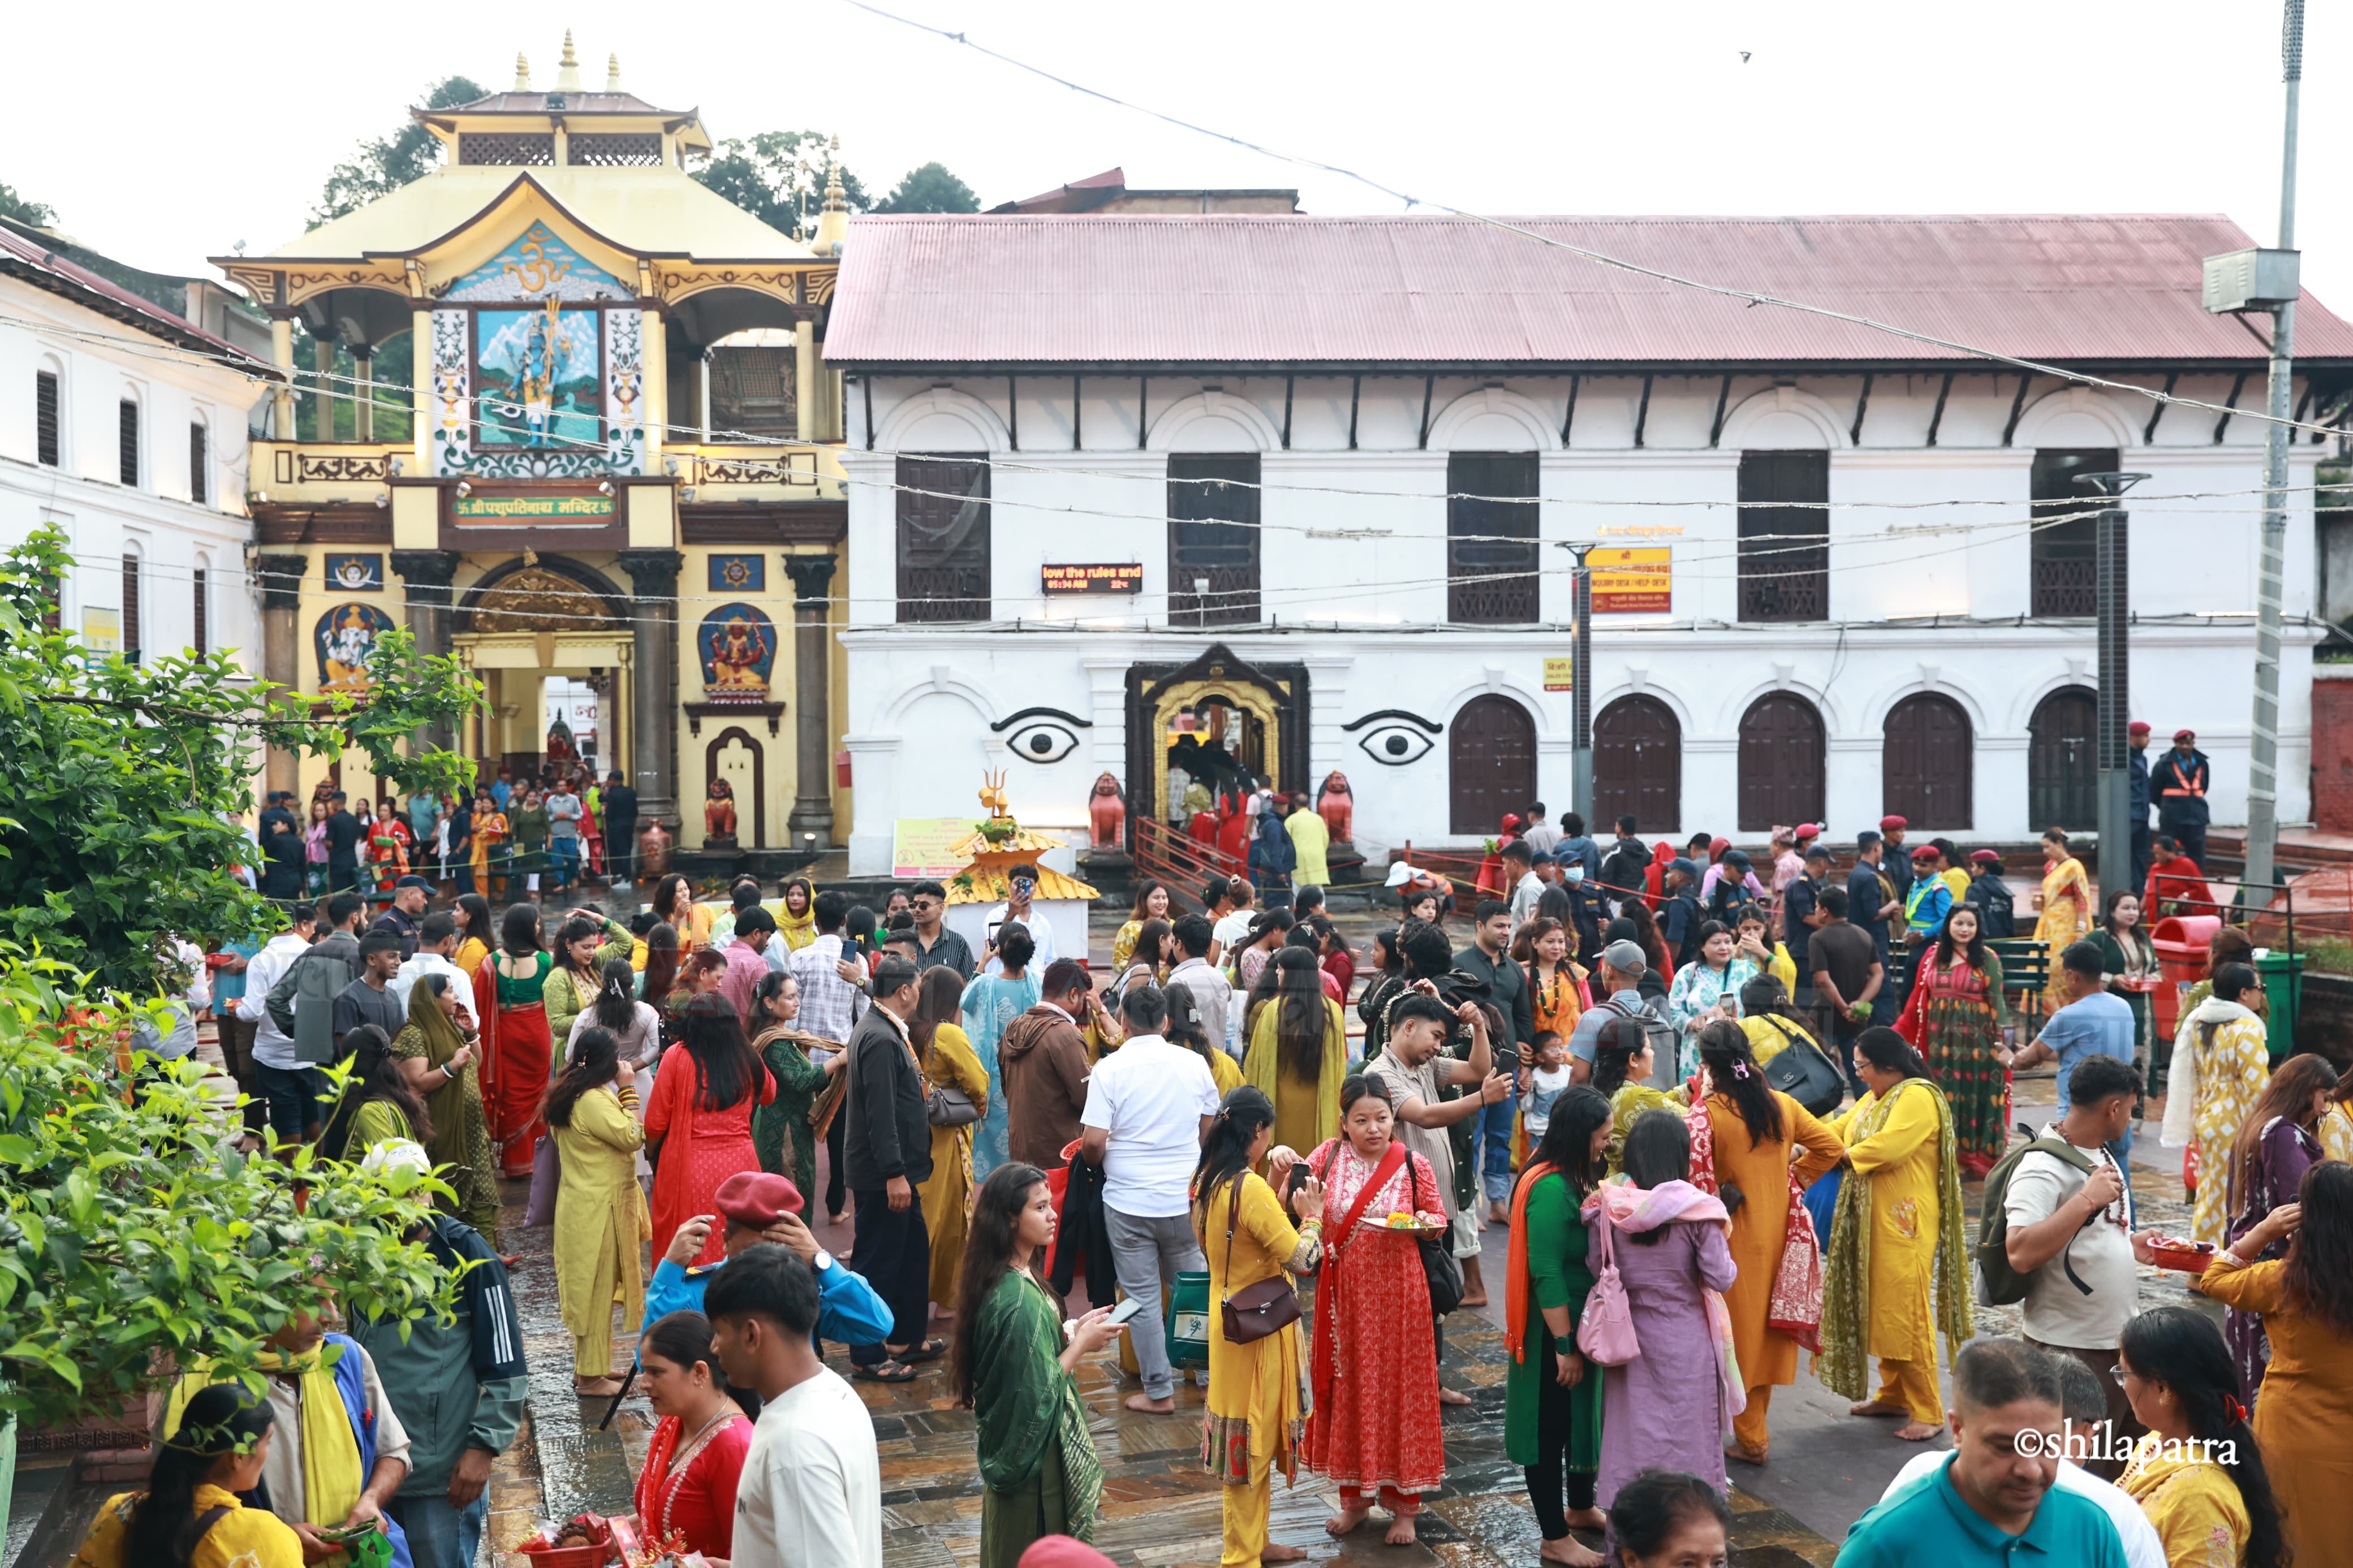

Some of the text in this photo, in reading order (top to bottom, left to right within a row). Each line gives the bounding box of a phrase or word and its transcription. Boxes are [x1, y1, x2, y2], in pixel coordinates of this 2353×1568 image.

[559, 497, 600, 515] मन्दिर
[1066, 566, 1085, 578] the
[1087, 566, 1117, 578] rules
[1118, 565, 1141, 577] and
